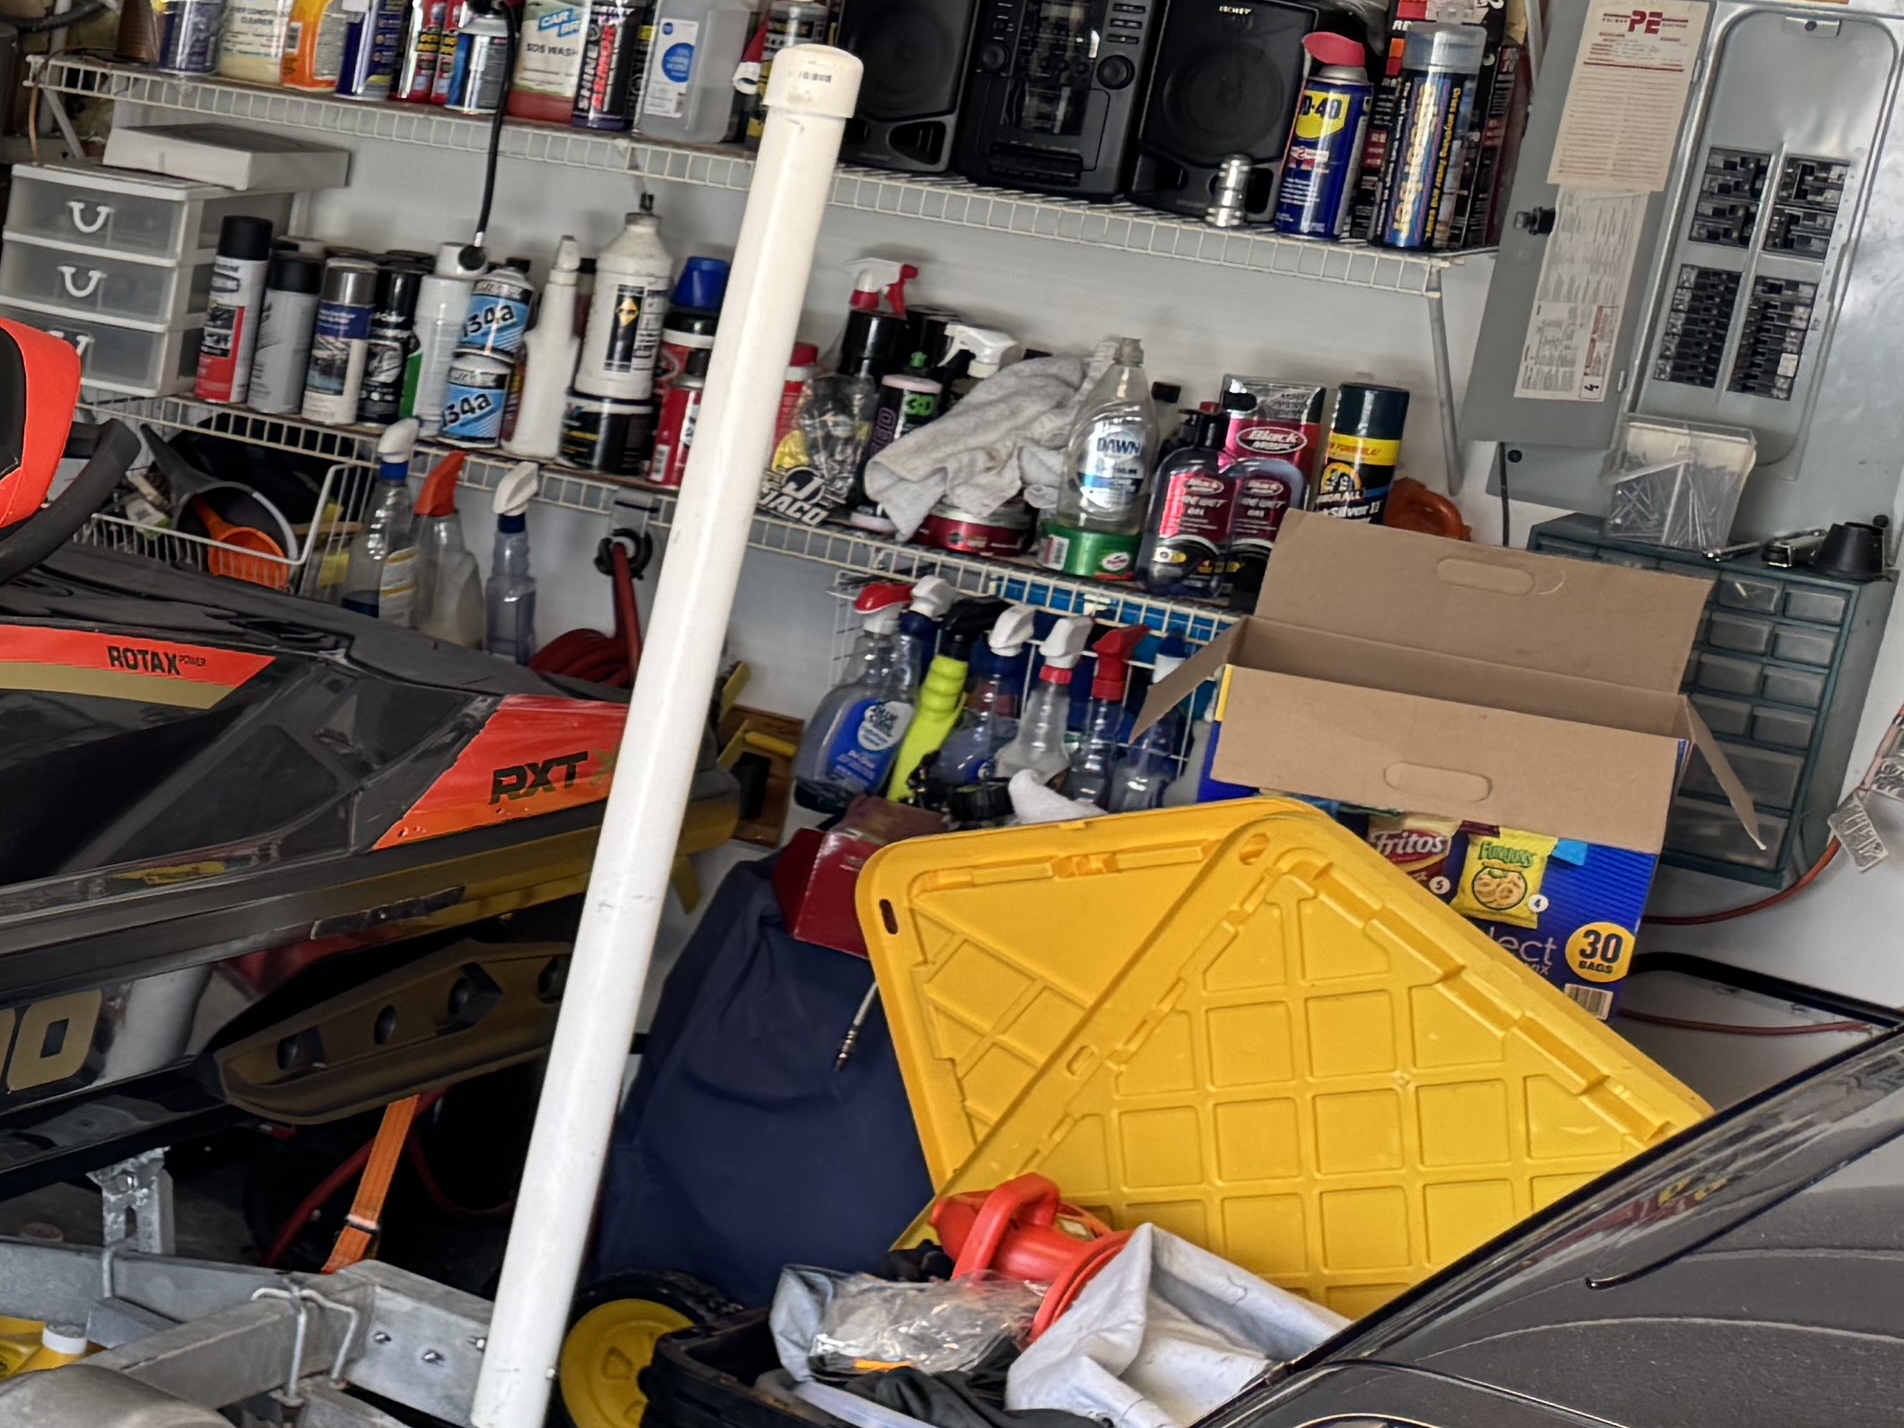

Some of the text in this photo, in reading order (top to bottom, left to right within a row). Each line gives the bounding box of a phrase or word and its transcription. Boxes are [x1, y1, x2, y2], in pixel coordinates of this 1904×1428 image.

[1627, 10, 1663, 34] PE
[1097, 437, 1141, 456] DAWN
[1245, 429, 1299, 444] Black
[759, 491, 829, 526] JACO
[106, 644, 206, 678] ROTAX POWER
[488, 751, 589, 806] RXT
[1374, 832, 1446, 856] Fritos
[1435, 879, 1444, 890] 5
[1534, 897, 1543, 908] 4
[1579, 929, 1624, 964] 30
[1578, 960, 1614, 975] BAGS
